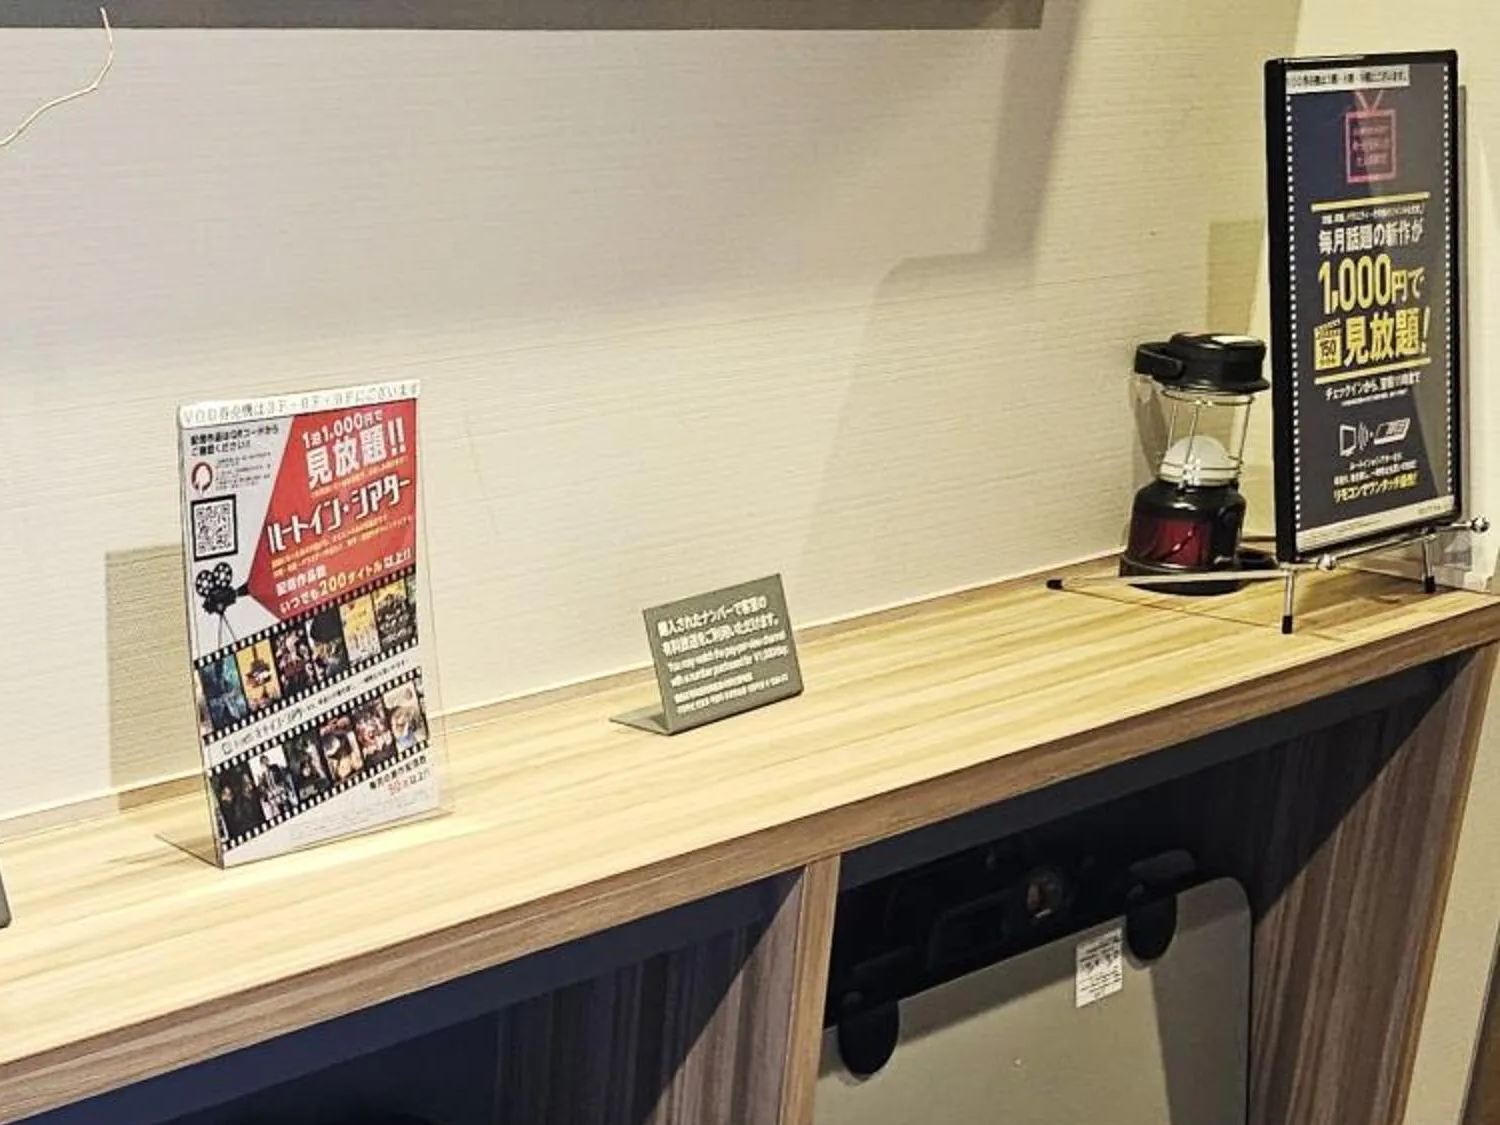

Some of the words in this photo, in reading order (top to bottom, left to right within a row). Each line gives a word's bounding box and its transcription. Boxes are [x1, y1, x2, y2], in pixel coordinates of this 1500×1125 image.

[1318, 217, 1423, 255] 毎月話題の新作が
[1318, 252, 1425, 315] 1,000円で
